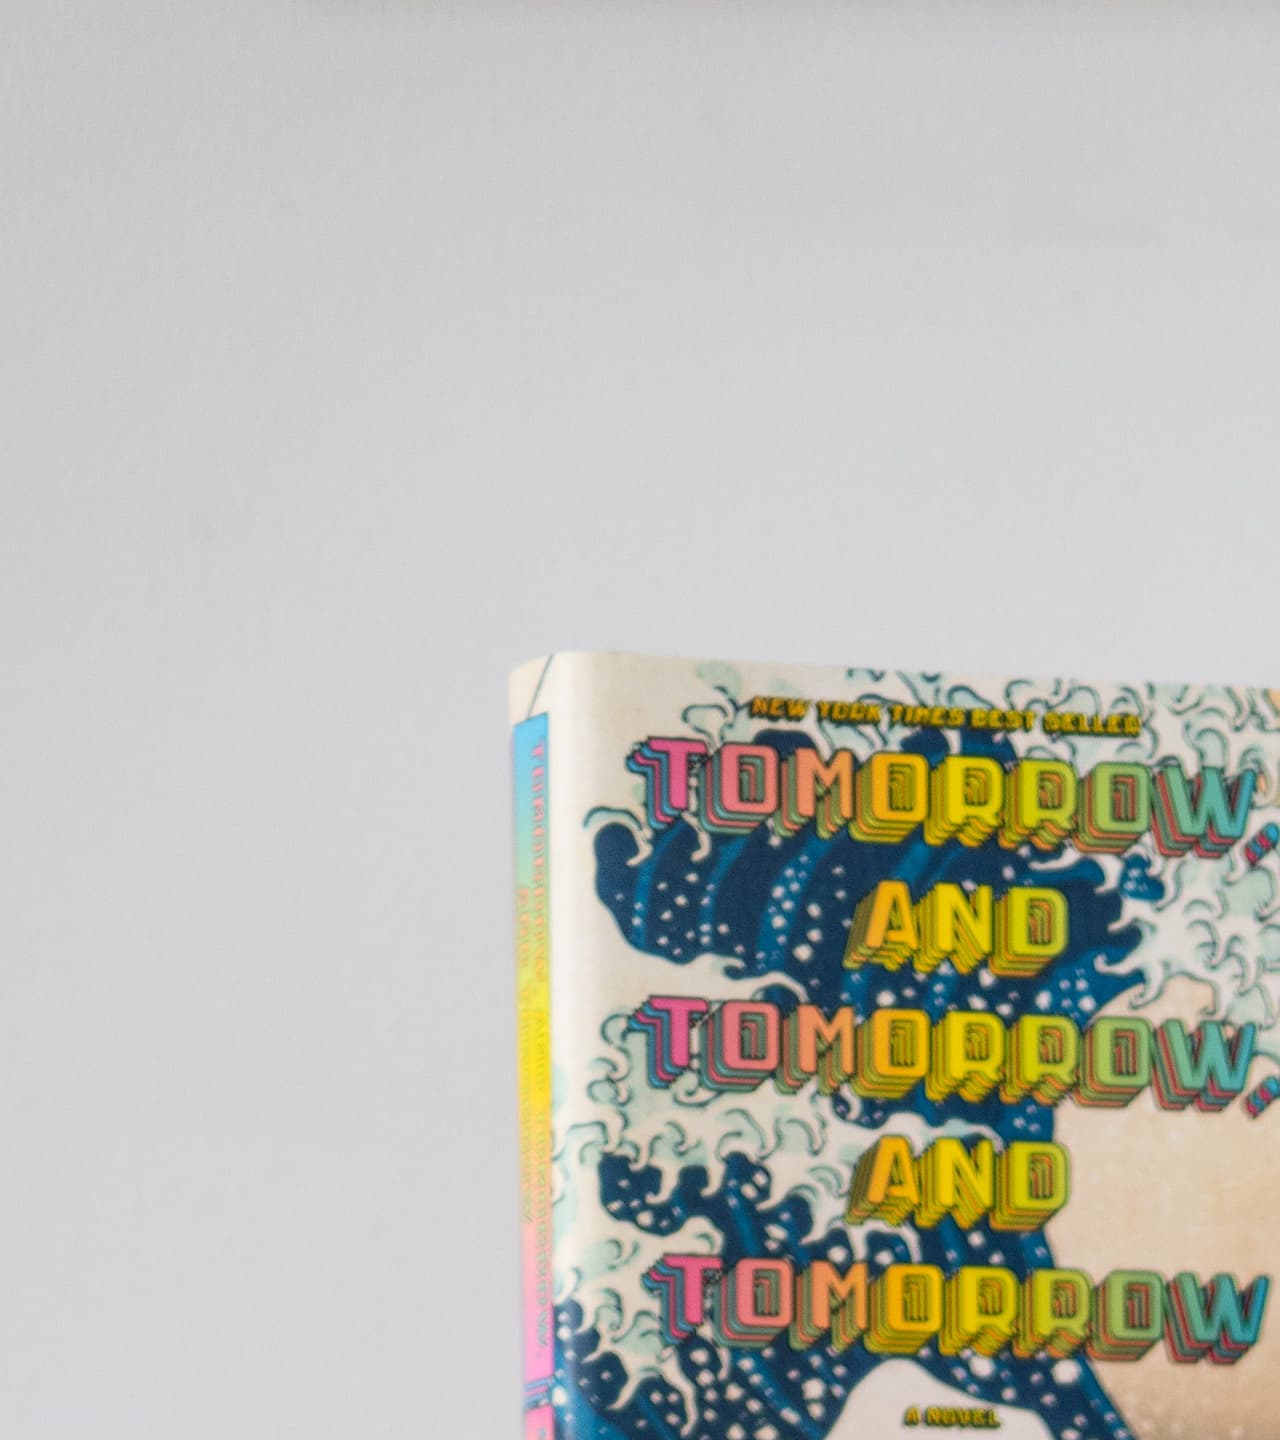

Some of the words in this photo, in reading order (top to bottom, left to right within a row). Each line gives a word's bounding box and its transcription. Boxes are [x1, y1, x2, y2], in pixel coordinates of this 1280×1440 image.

[845, 879, 1068, 975] AND
[845, 1134, 1070, 1232] AND
[643, 1253, 1271, 1364] TOMORROW
[903, 1407, 921, 1427] A
[926, 1407, 1001, 1429] NOVEL
